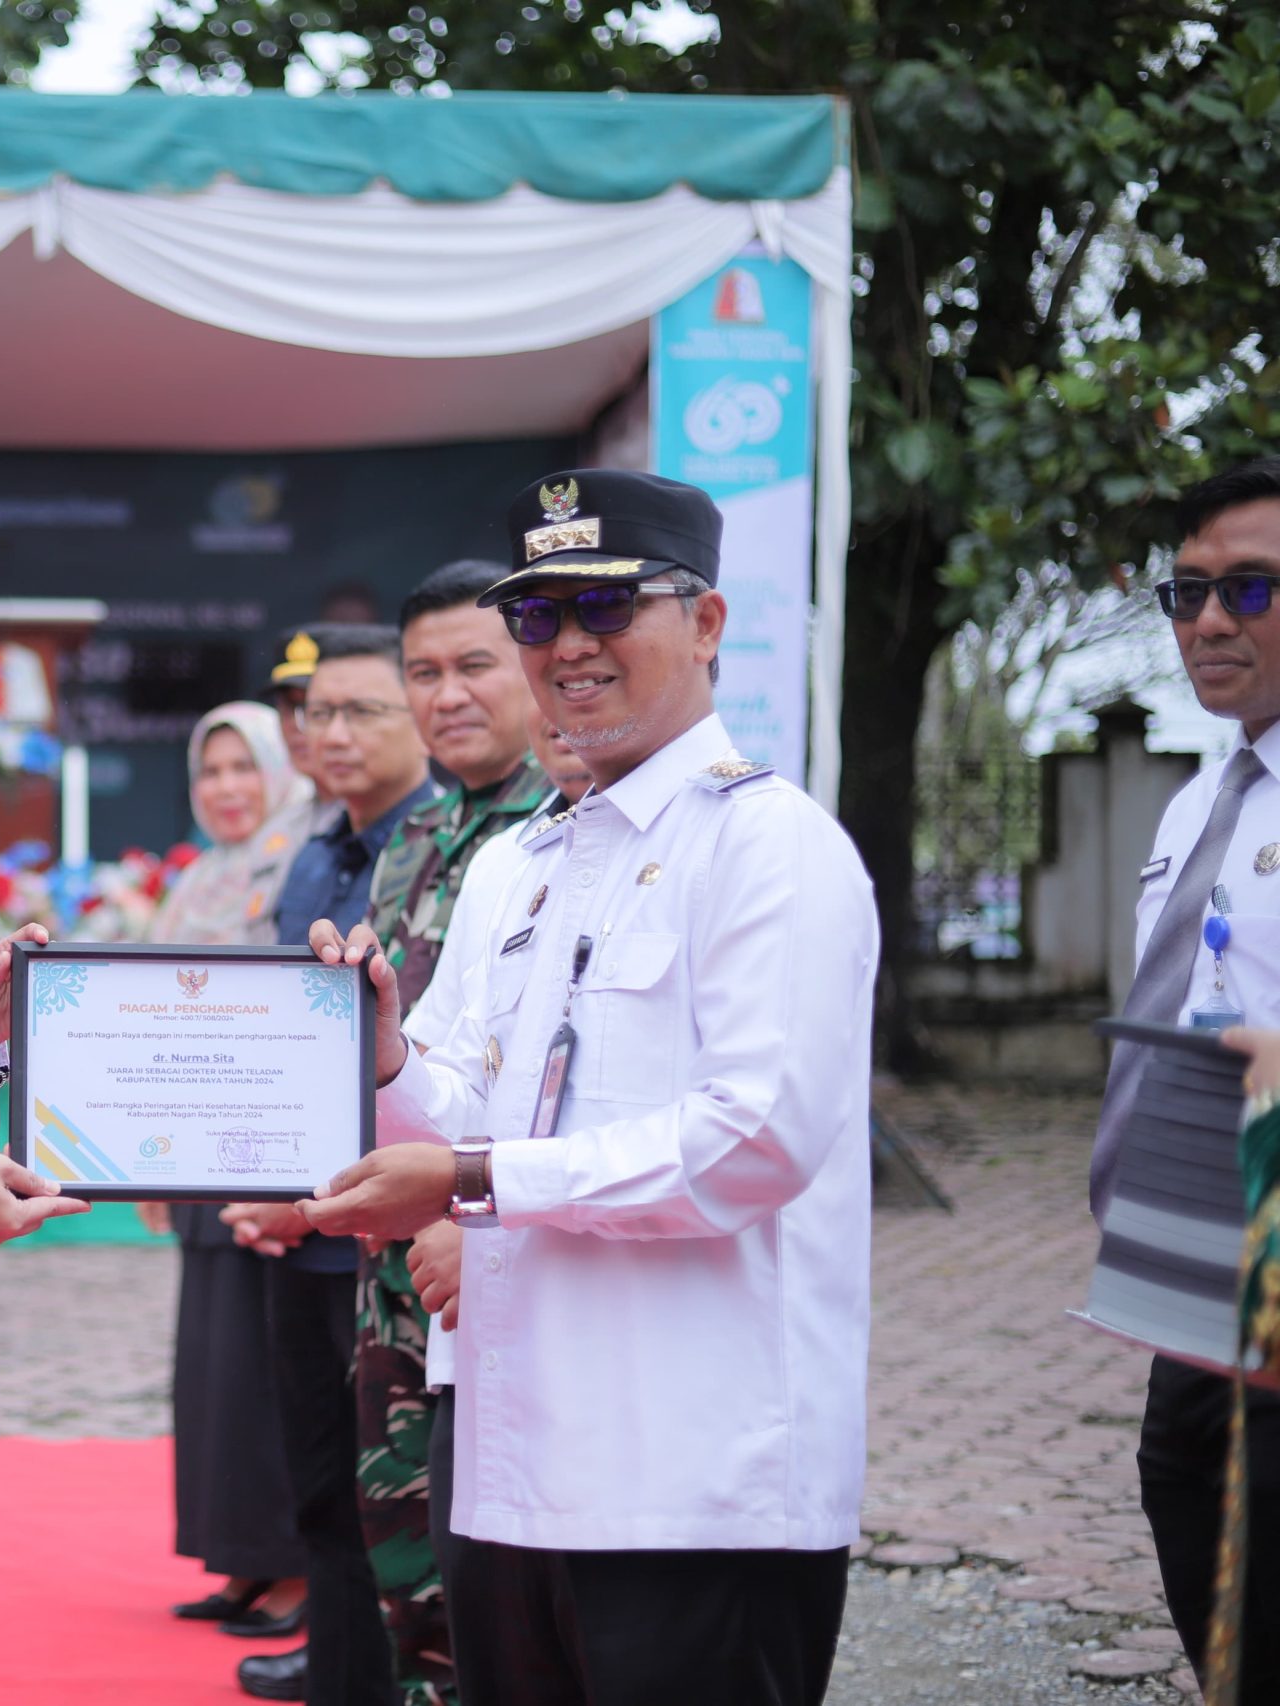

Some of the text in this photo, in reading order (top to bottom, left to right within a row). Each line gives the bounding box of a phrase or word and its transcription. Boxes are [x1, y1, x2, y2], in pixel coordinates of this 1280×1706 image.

[119, 1004, 269, 1014] PIAGAM PENGHARGAAN
[67, 1031, 94, 1040] Bupati
[95, 1031, 120, 1040] Nagan
[121, 1031, 141, 1040] Raya
[142, 1031, 171, 1041] dengan
[172, 1031, 183, 1040] ini
[184, 1031, 234, 1040] memberikan
[235, 1032, 287, 1042] penghargaan
[152, 1053, 235, 1064] dr. Nurma Sita
[106, 1067, 135, 1075] JUARA
[135, 1067, 144, 1075] III
[145, 1067, 181, 1075] SEBAGAI
[182, 1067, 217, 1076] DOKTER
[245, 1068, 283, 1076] TELADAN
[116, 1076, 167, 1084] KABUPATEN
[199, 1077, 222, 1085] RAYA
[224, 1077, 253, 1085] TAHUN
[254, 1077, 274, 1085] 2024
[86, 1101, 112, 1109] Dalam
[113, 1101, 143, 1110] Rangka
[143, 1102, 187, 1111] Peringatan
[187, 1102, 205, 1110] Hari
[205, 1102, 247, 1110] Kesehatan
[247, 1102, 281, 1110] Nasional
[293, 1103, 304, 1111] 60
[127, 1110, 264, 1120] Kabupaten Nagan Raya Tahun 2024
